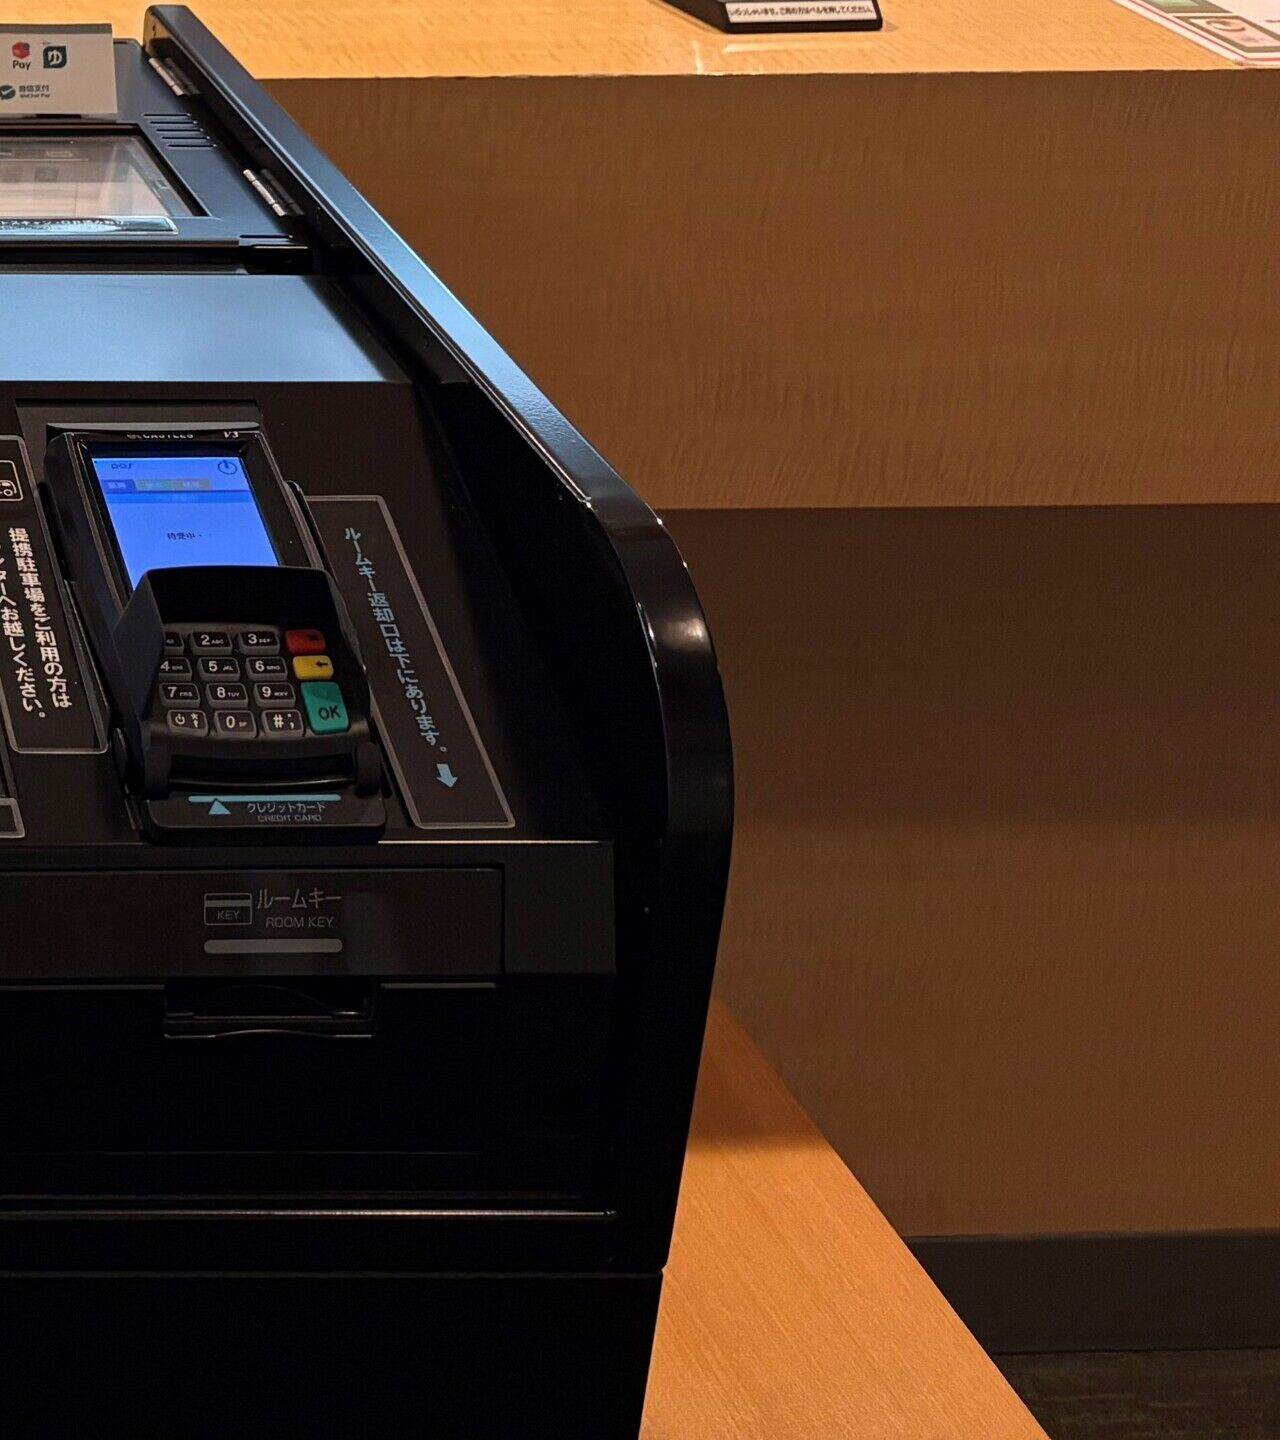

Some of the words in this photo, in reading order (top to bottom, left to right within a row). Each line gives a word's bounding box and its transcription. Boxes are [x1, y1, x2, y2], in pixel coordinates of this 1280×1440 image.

[12, 60, 31, 70] Pay
[8, 527, 73, 709] 提携駐車場をご利用の方は
[201, 634, 211, 646] 2
[248, 634, 258, 644] 3
[345, 527, 447, 753] ルームキー返却口は下にあります。
[160, 661, 170, 672] 4
[208, 661, 218, 672] 5
[255, 661, 265, 672] 6
[168, 687, 178, 697] 7
[216, 687, 226, 697] 8
[262, 687, 271, 697] 9
[318, 706, 341, 720] OK
[226, 716, 235, 728] 0
[247, 802, 326, 814] クレジットカード
[257, 888, 342, 909] ルームキー
[266, 917, 305, 929] ROOM
[308, 916, 334, 928] KEY
